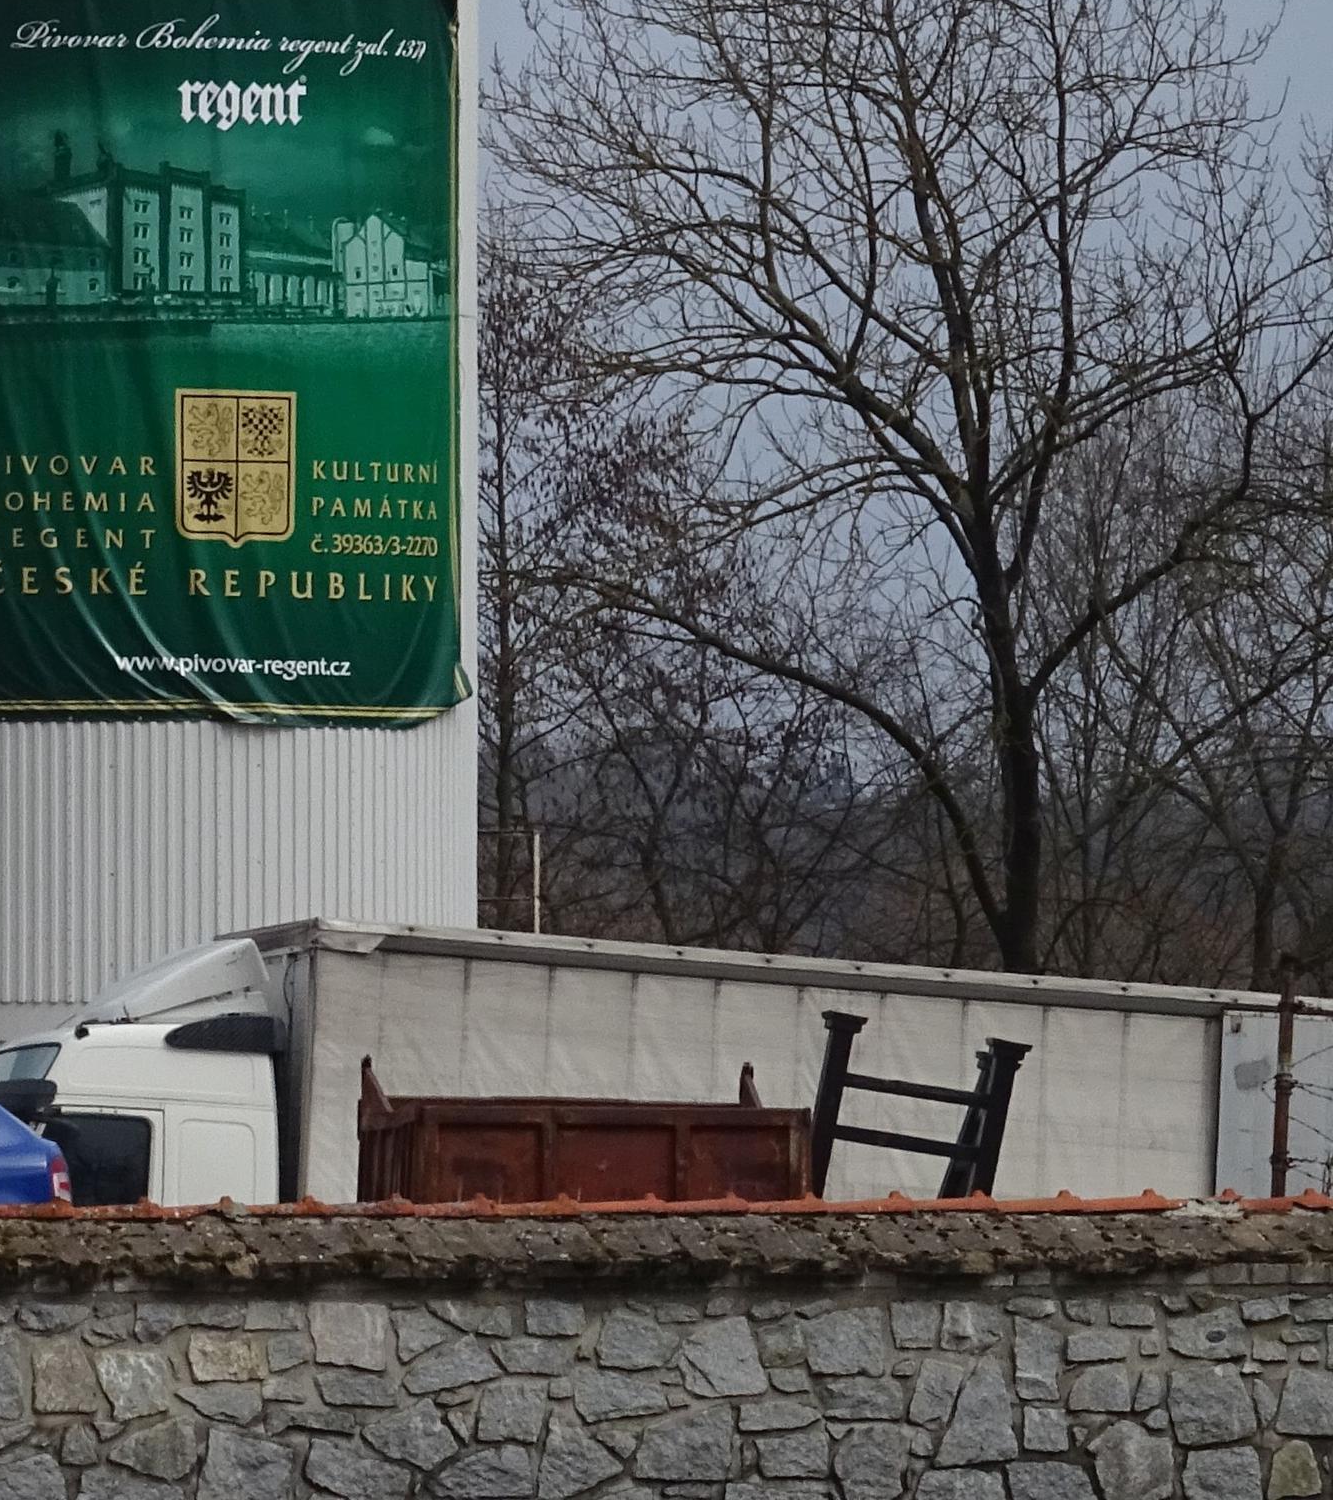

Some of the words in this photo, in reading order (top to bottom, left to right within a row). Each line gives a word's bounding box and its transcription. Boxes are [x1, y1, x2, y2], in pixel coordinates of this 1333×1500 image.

[10, 19, 129, 49] Pivovar
[136, 13, 272, 51] Bohemia
[279, 34, 355, 74] regent
[340, 29, 394, 76] zal.
[177, 79, 307, 131] regent
[312, 460, 438, 485] KULTURNÍ
[311, 493, 438, 520] PAMÁTKA
[189, 570, 438, 602] REPUBLIKY
[115, 653, 351, 681] www.pivovar-regent.cz
